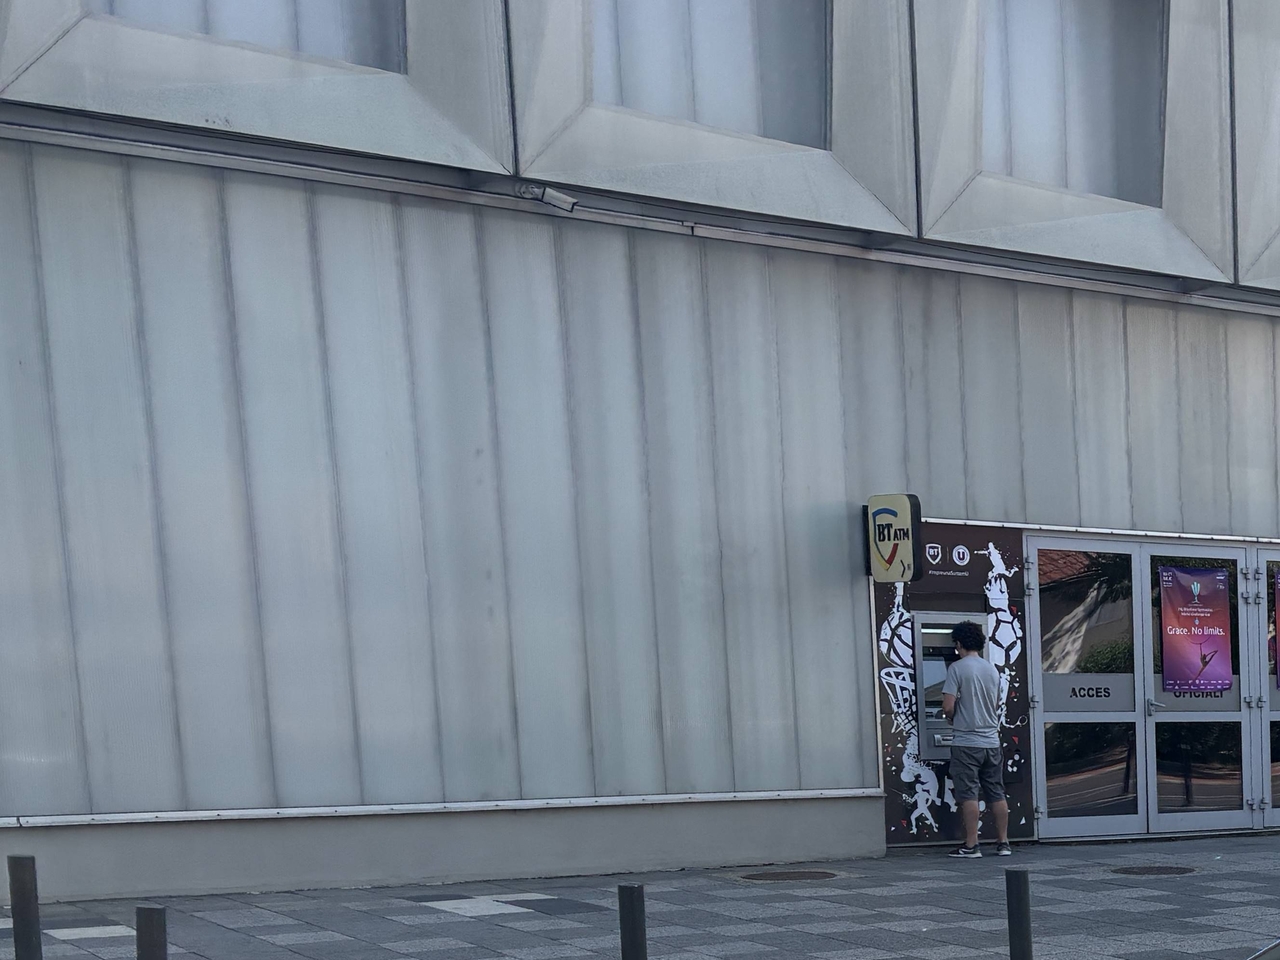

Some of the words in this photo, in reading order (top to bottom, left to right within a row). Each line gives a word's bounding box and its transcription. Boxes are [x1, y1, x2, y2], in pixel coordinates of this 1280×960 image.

[877, 523, 893, 542] BT
[893, 528, 909, 541] ATM
[1167, 626, 1190, 635] Grace.
[1192, 626, 1202, 635] No
[1203, 626, 1225, 636] limits.
[1070, 687, 1111, 698] ACCES
